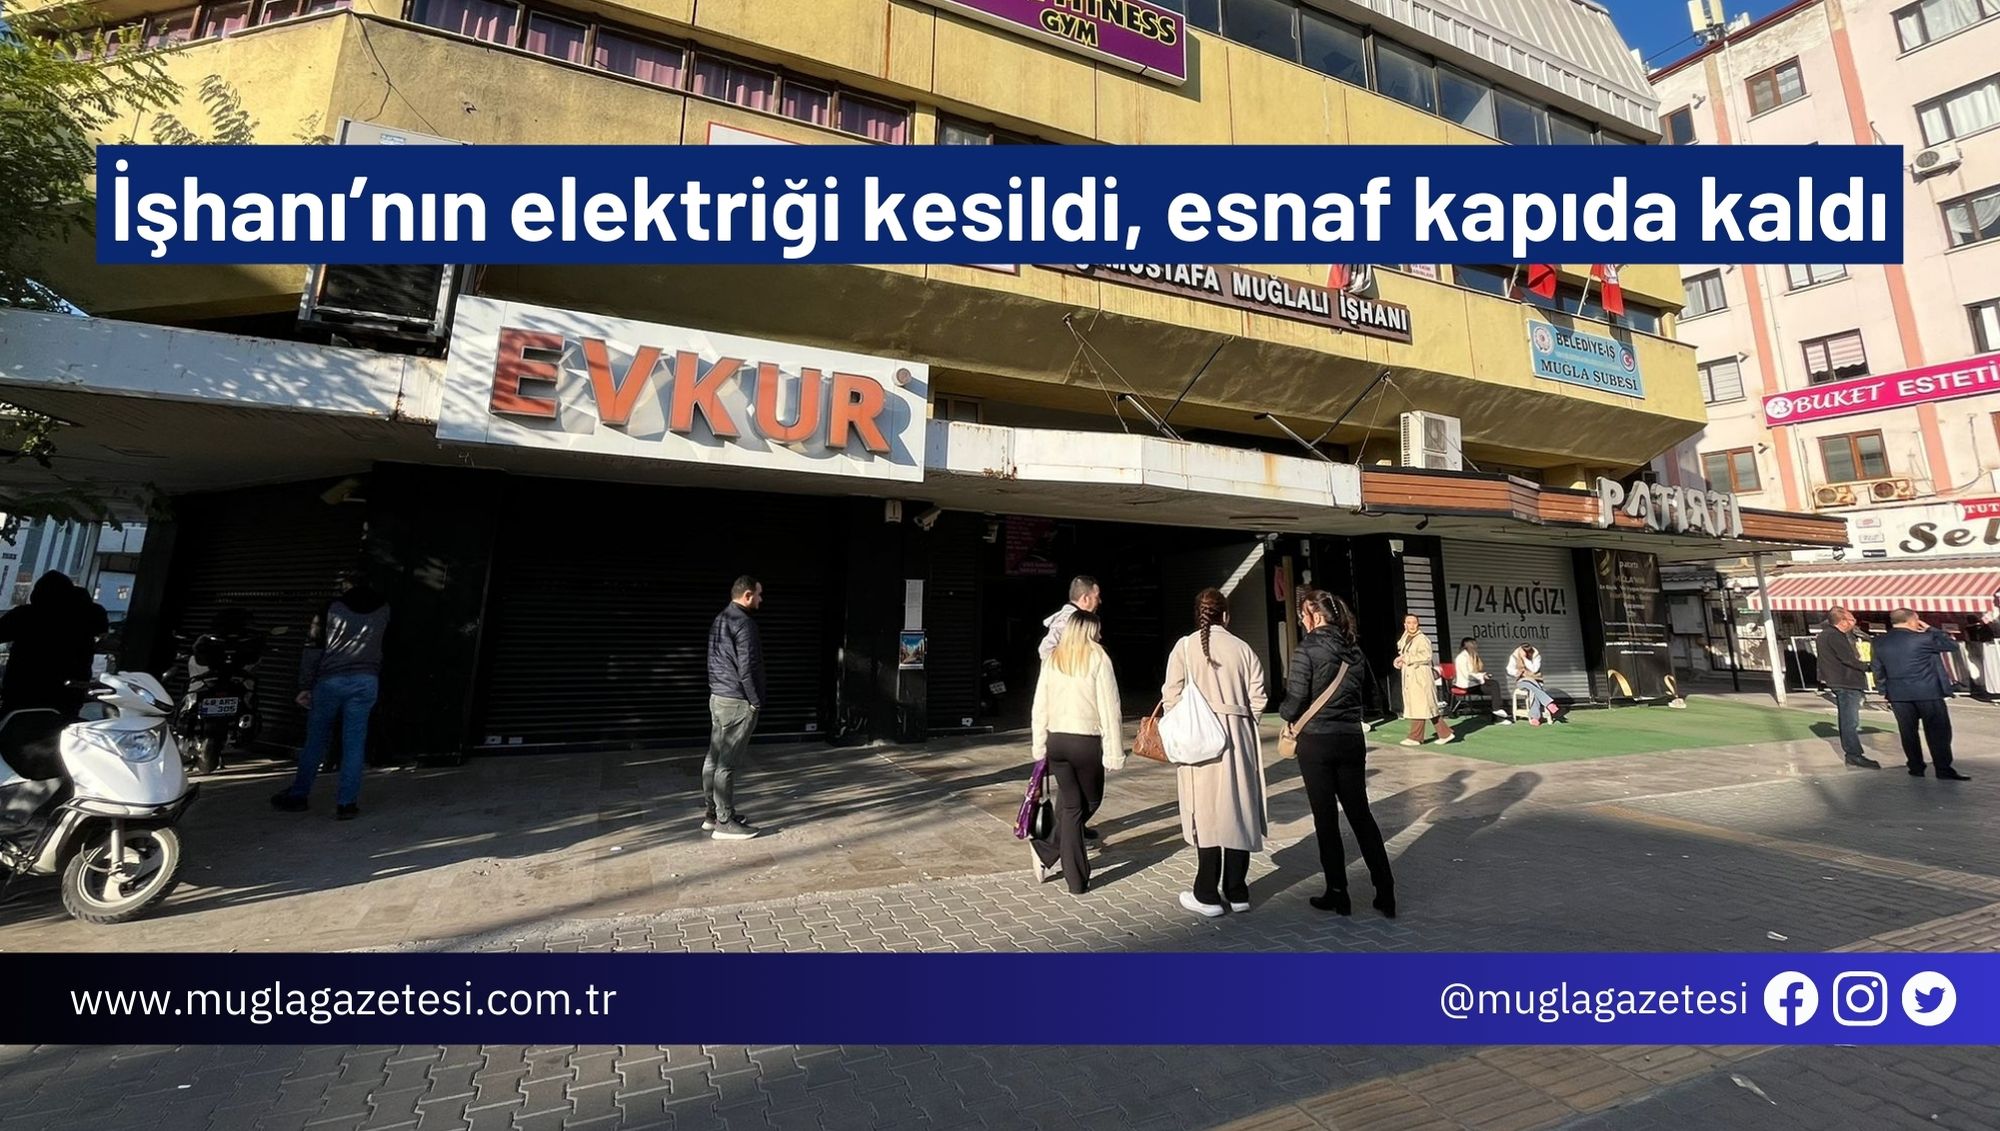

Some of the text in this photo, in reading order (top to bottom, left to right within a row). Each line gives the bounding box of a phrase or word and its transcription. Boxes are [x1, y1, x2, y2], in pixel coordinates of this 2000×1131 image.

[1039, 8, 1099, 47] GYM
[1054, 0, 1177, 46] TNESS
[1107, 264, 1408, 331] STAFA MUĞLALI İŞHANI
[1555, 332, 1616, 363] BELEDİYE-İŞ
[490, 326, 893, 453] EVKUR
[1540, 359, 1590, 380] MUĞLA
[1793, 360, 2000, 413] BUKET ESTETİ
[1450, 581, 1567, 621] 7/24 AÇIĞIZ!
[1472, 622, 1550, 639] patirti.com.tr
